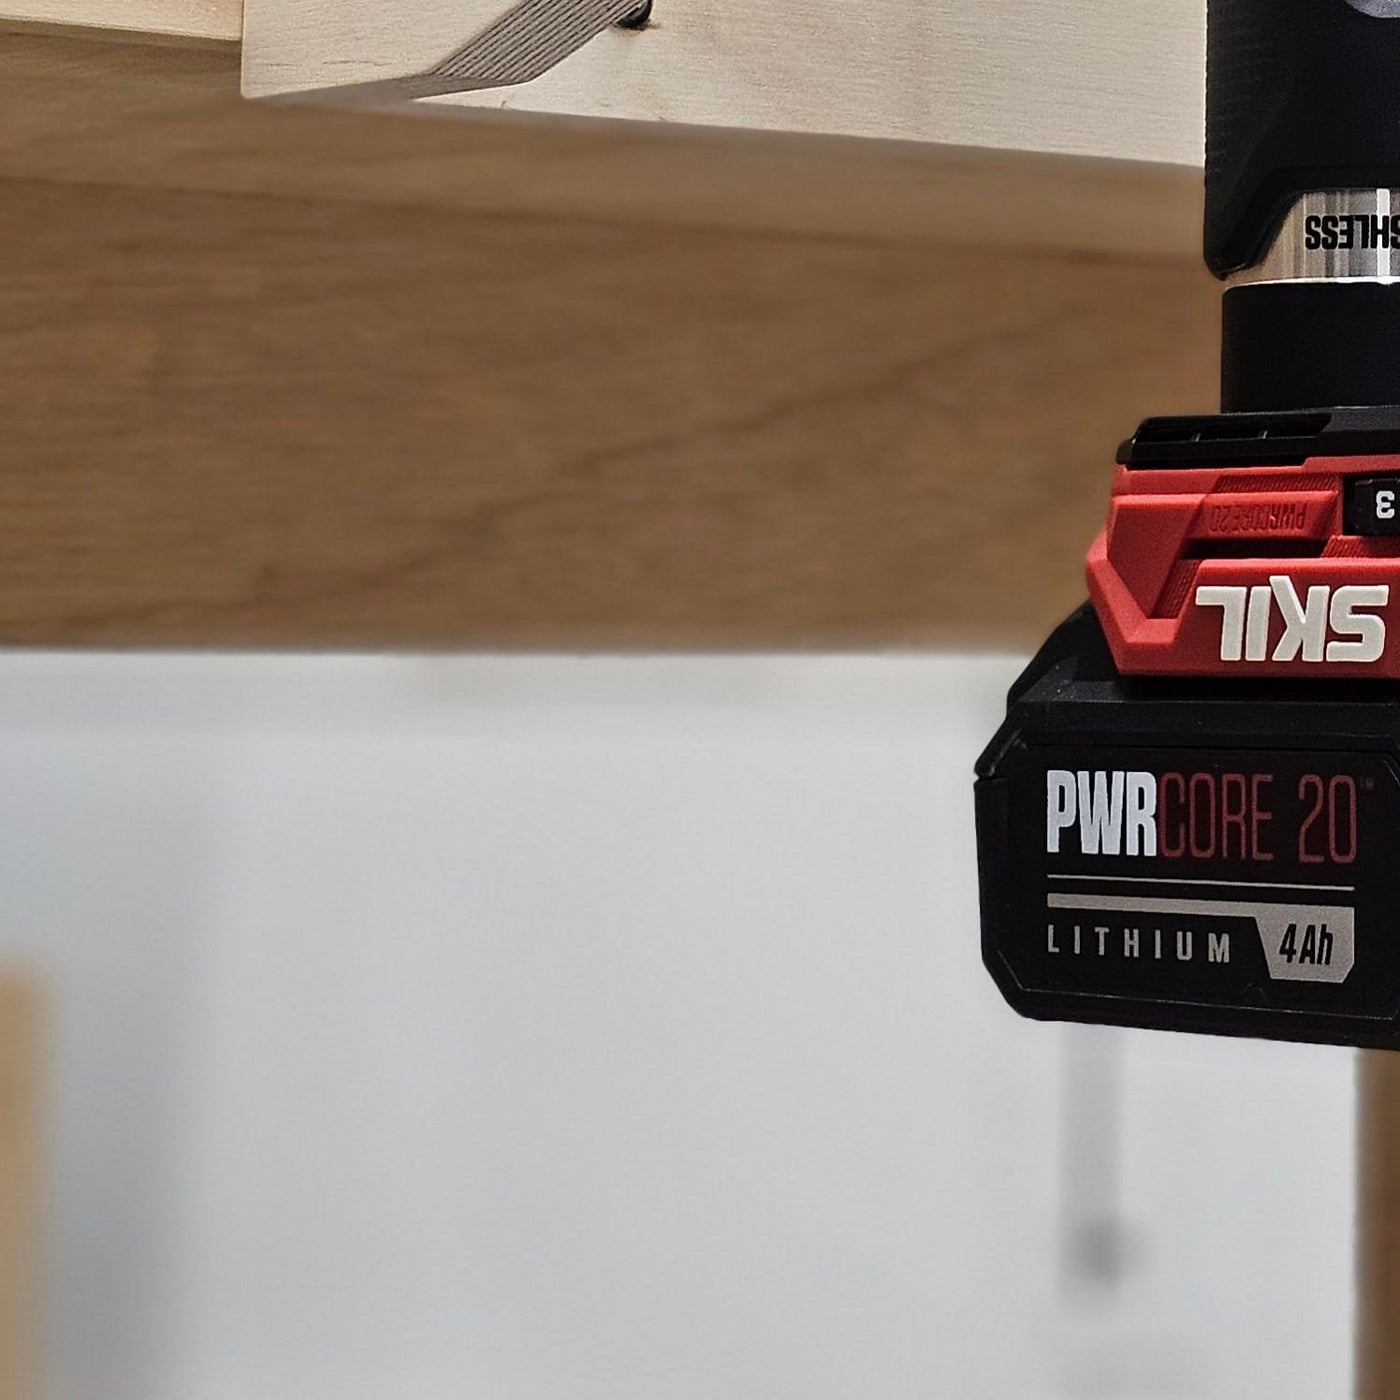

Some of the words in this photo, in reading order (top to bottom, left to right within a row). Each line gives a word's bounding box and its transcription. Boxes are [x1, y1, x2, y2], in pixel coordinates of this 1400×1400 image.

[1376, 490, 1395, 518] 3
[1196, 575, 1389, 663] SKIL
[1047, 770, 1274, 861] PWRCORE
[1047, 925, 1230, 963] LITHIUM
[1279, 923, 1334, 966] 4Ah
